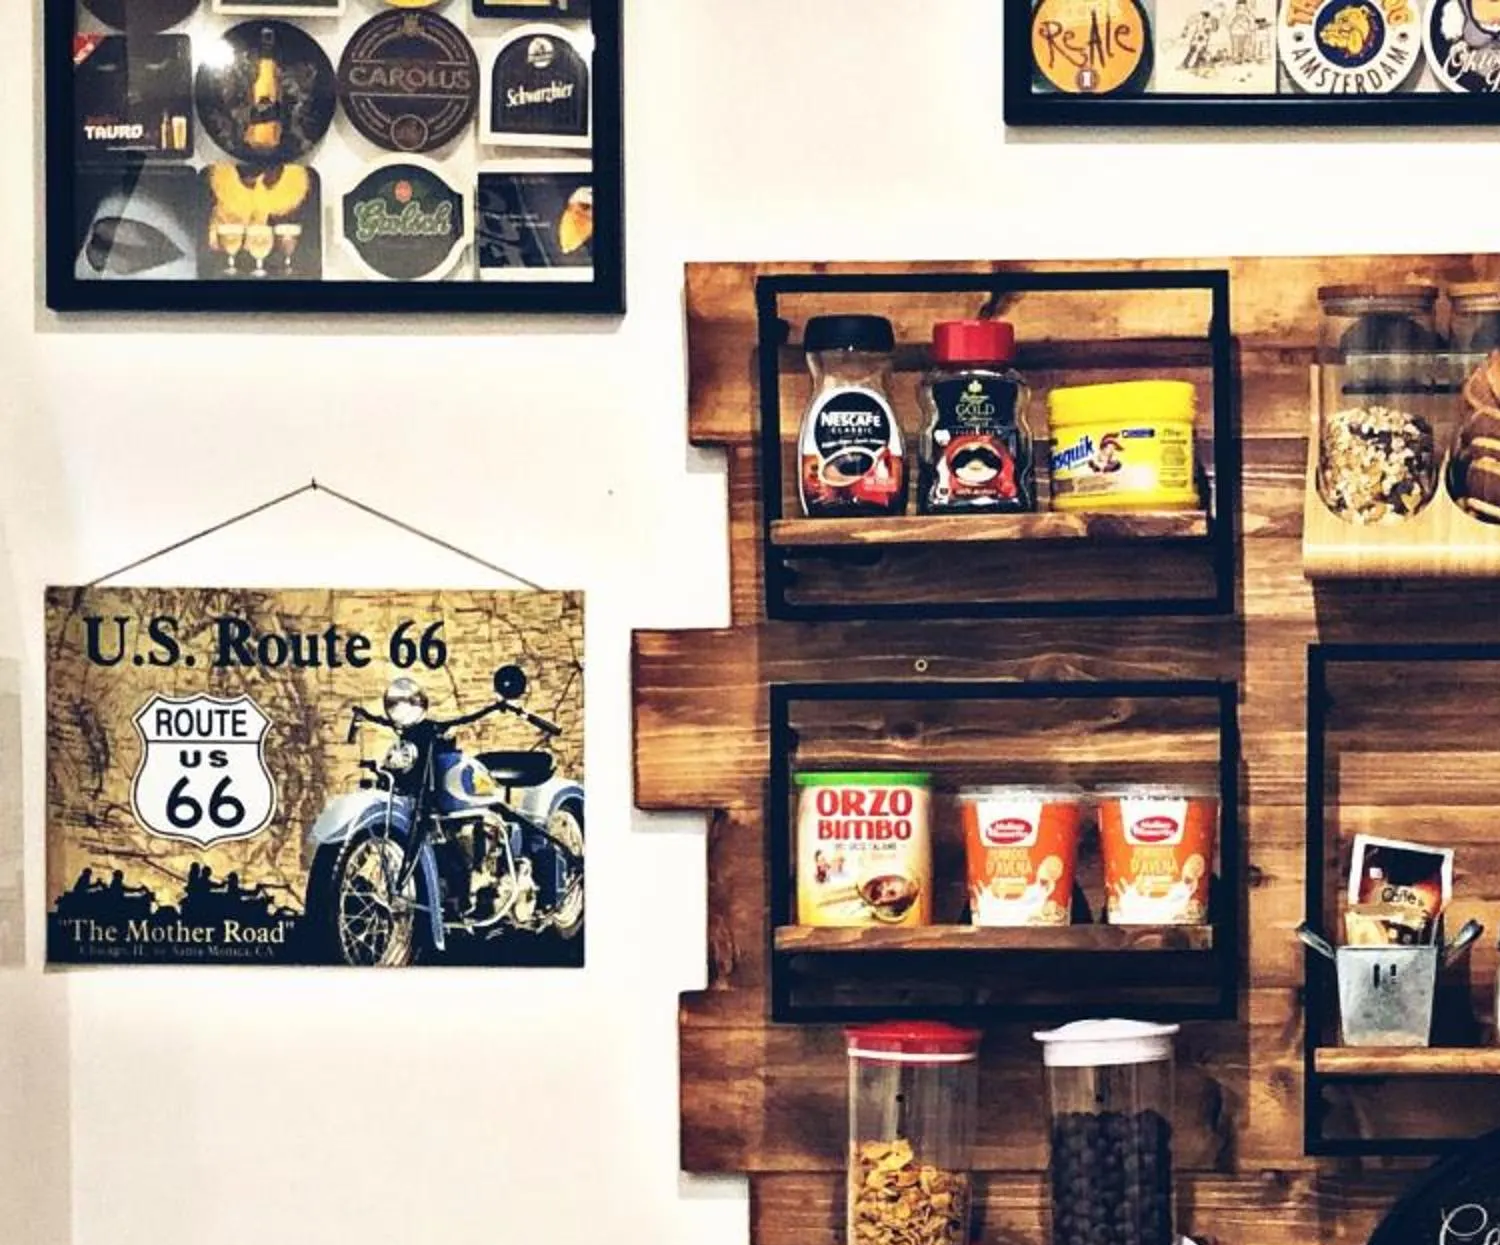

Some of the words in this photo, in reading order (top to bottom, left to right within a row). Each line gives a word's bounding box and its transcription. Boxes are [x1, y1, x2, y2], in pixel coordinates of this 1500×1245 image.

[349, 67, 471, 93] CAROLUS
[1290, 47, 1409, 93] AMSTERDAM
[955, 404, 995, 416] GOLD
[83, 614, 195, 669] U.S.
[212, 618, 371, 669] Route
[389, 619, 447, 669] 66
[155, 709, 248, 737] ROUTE
[179, 749, 229, 768] US
[165, 775, 246, 828] 66
[816, 789, 913, 817] ORZO
[817, 819, 912, 840] BIMBO
[125, 919, 215, 943] Mother
